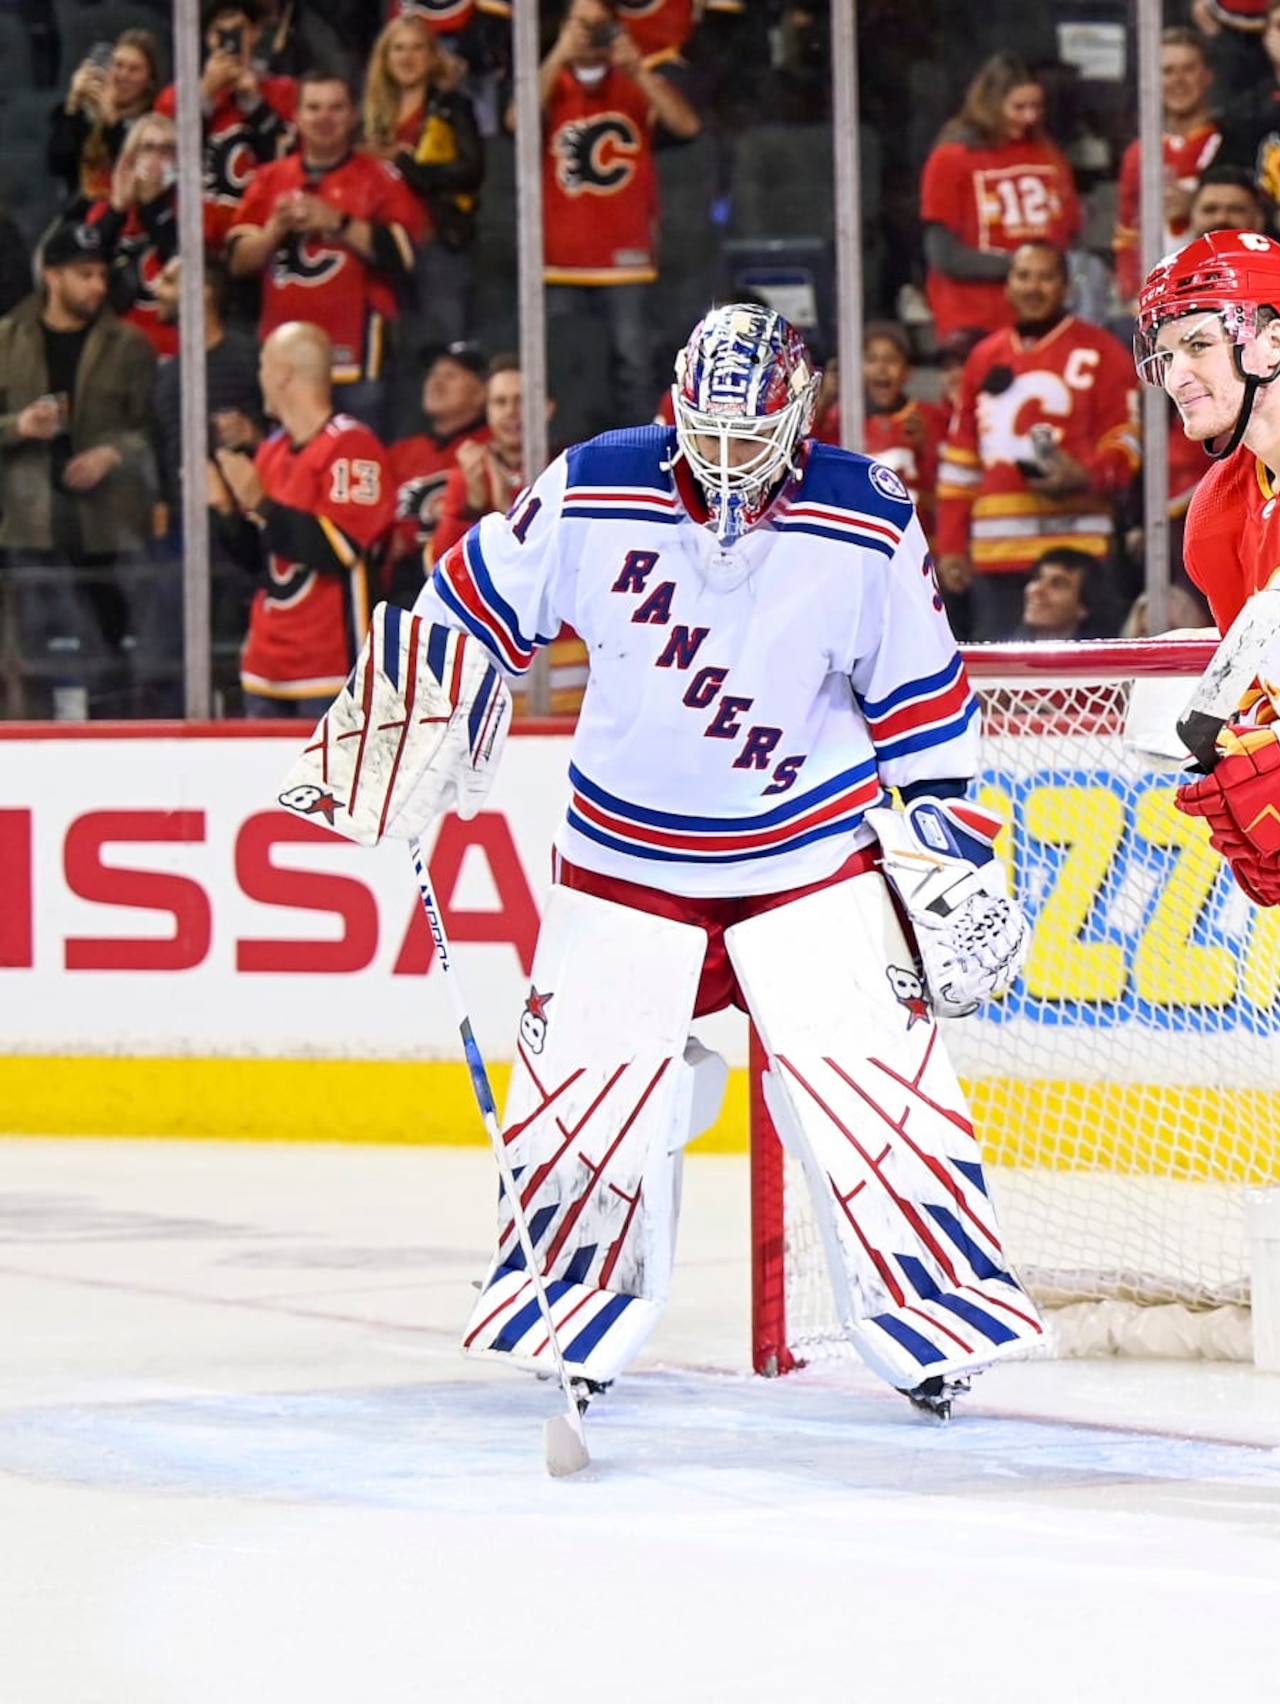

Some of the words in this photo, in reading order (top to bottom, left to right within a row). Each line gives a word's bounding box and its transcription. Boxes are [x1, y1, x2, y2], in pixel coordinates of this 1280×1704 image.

[996, 175, 1048, 226] 12
[1064, 347, 1100, 391] C
[329, 457, 382, 506] 13
[610, 549, 807, 796] RANGERS
